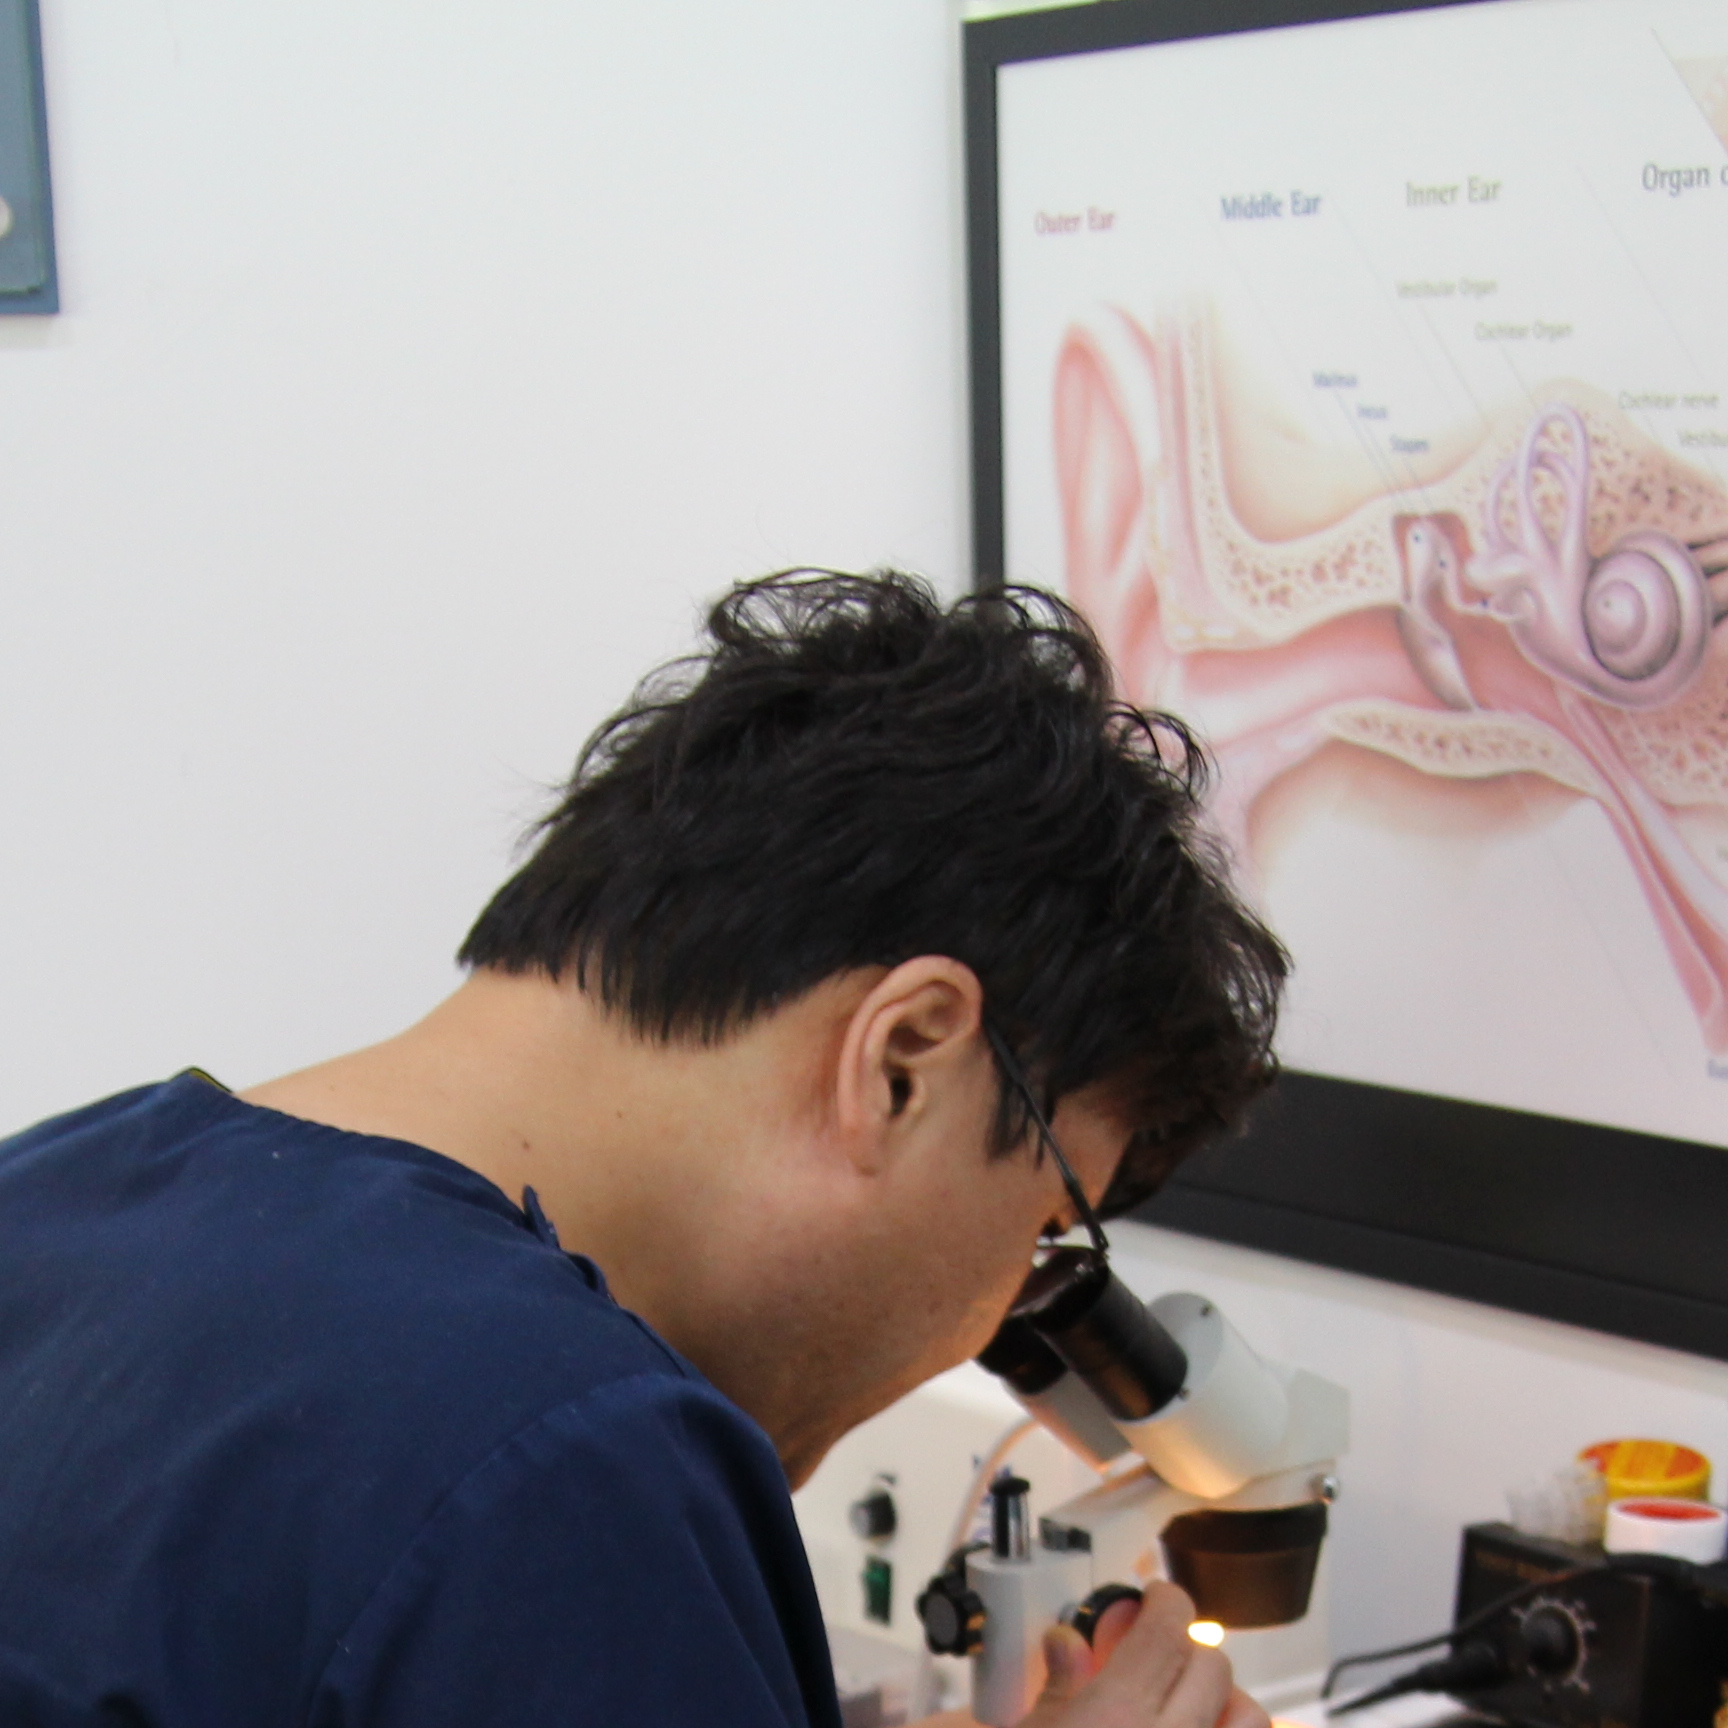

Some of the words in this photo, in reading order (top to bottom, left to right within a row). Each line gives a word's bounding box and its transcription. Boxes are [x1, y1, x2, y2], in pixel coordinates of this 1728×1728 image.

[1406, 181, 1460, 207] Inner
[1468, 175, 1502, 203] Ear
[1642, 162, 1711, 198] Organ
[1221, 192, 1283, 219] Middle
[1290, 189, 1322, 216] Ear
[1035, 210, 1081, 235] Outer
[1087, 205, 1115, 230] Ear
